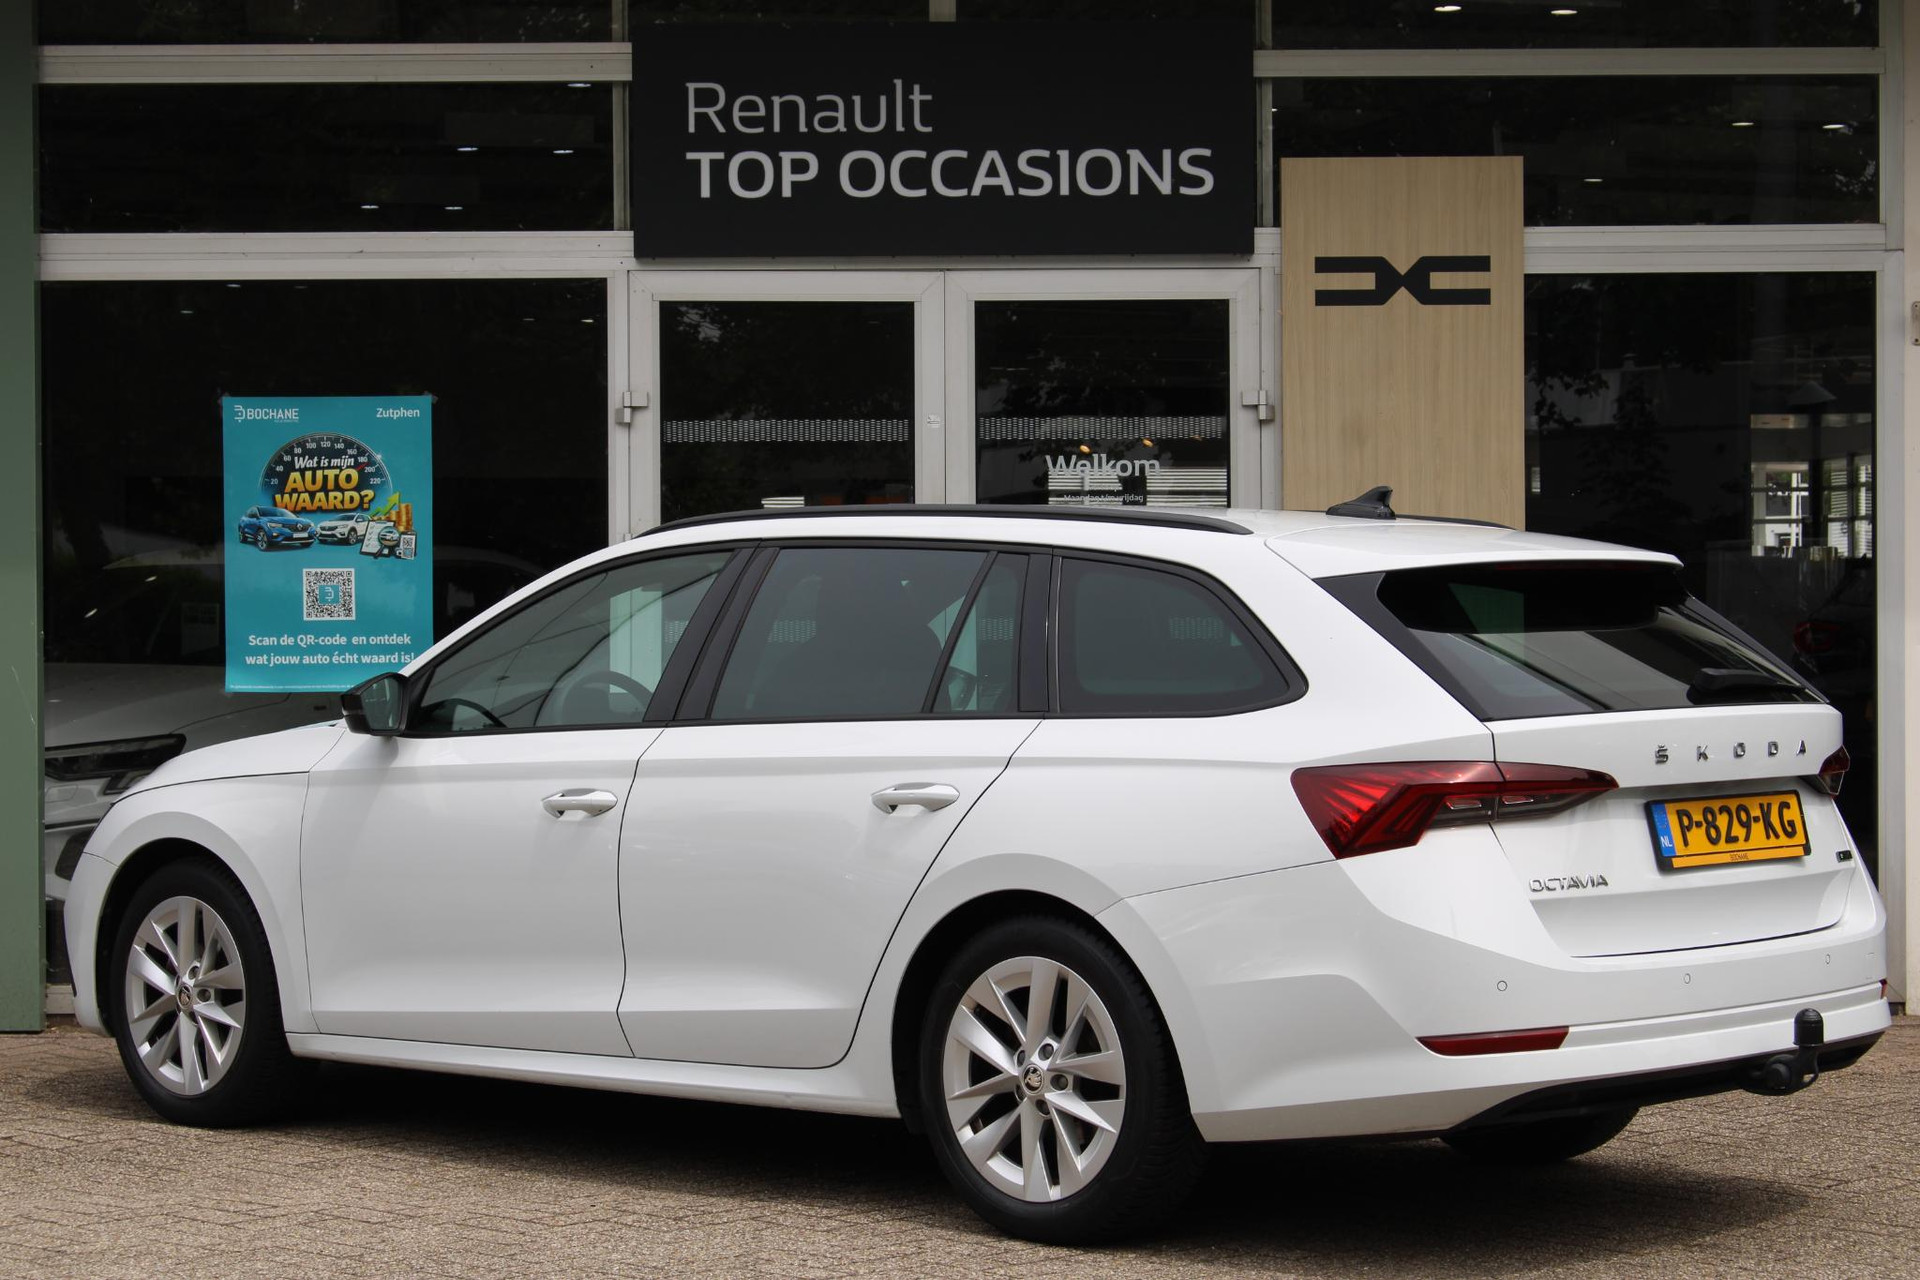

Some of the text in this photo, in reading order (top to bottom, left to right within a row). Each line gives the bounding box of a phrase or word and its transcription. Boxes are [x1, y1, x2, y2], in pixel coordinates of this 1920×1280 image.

[685, 79, 933, 134] Renault
[685, 147, 1215, 199] TOP OCCASIONS
[246, 408, 300, 420] BOCHANE
[376, 407, 420, 419] Zutphen
[293, 455, 355, 470] Wat is mijn
[1045, 453, 1161, 477] Welkom
[284, 468, 359, 494] AUTO
[369, 477, 381, 485] 220
[274, 489, 375, 512] WAARD?
[248, 633, 412, 648] Scan de QR-code en ontdek
[245, 655, 268, 665] wat
[270, 653, 300, 667] jouw
[302, 655, 330, 664] auto
[332, 651, 358, 664] écht
[360, 652, 398, 664] waard
[1655, 740, 1807, 764] ŠKODA
[1676, 801, 1797, 848] P-829-KG
[1660, 836, 1673, 848] NL
[1528, 873, 1609, 892] OCTAVIA
